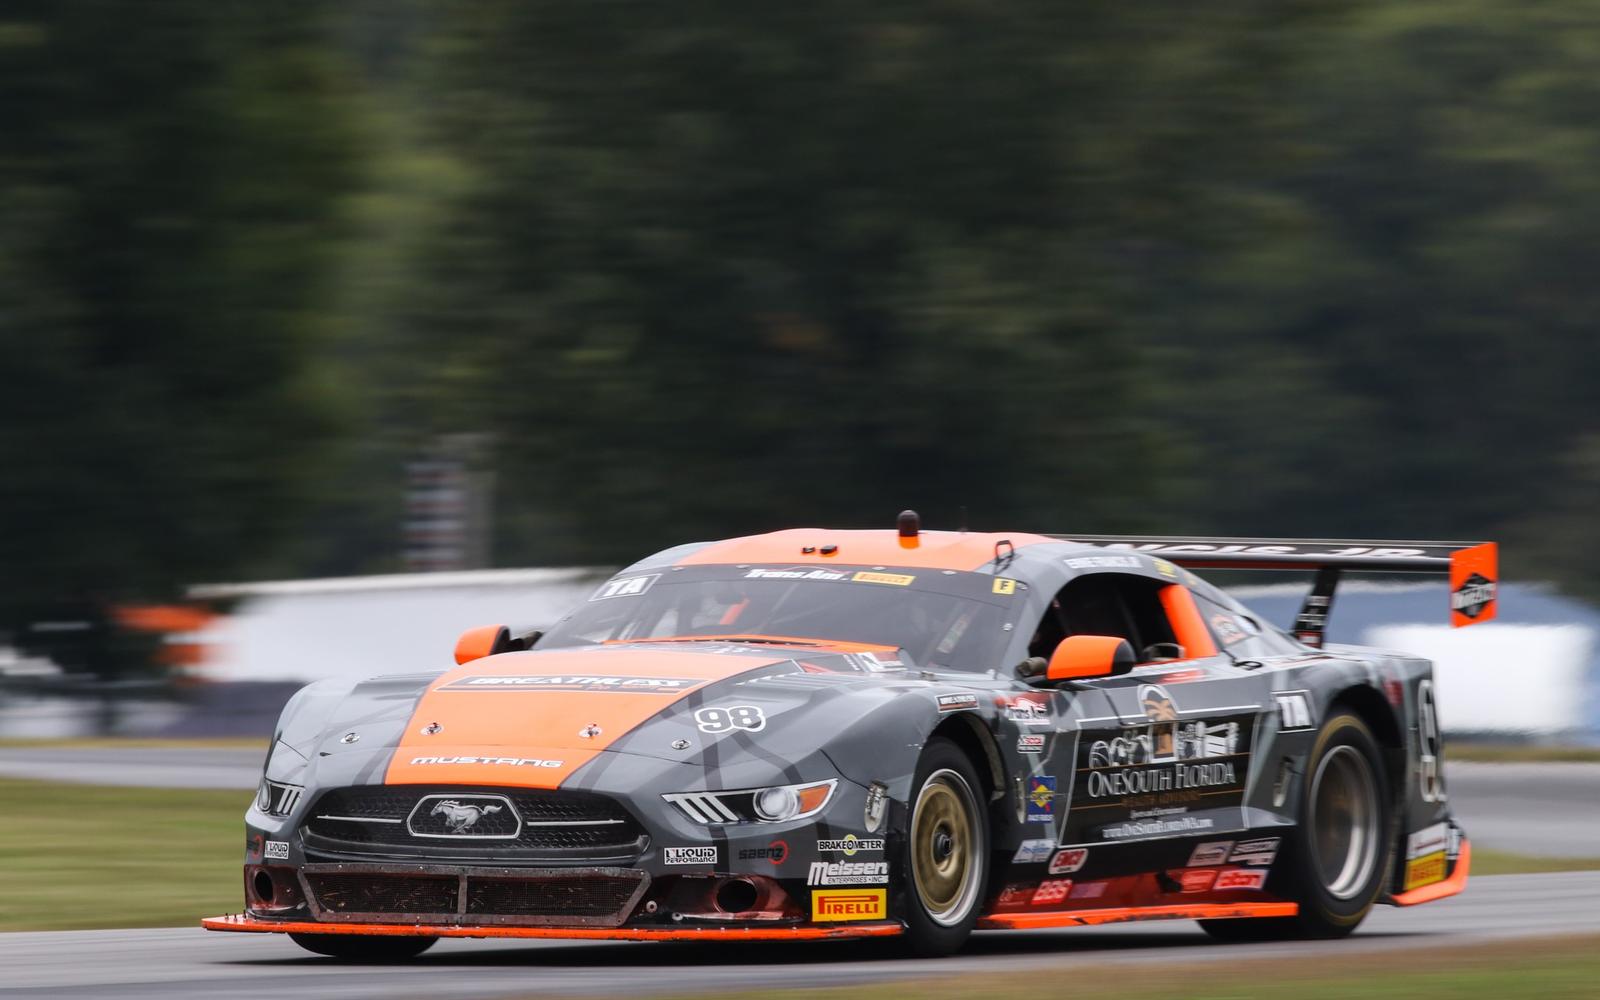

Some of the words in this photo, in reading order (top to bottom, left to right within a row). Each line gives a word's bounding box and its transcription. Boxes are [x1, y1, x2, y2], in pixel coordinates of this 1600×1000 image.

[602, 577, 649, 597] TA
[468, 676, 688, 688] BREATHLESS
[694, 705, 766, 733] 98
[410, 756, 564, 768] MUSTANG
[807, 860, 888, 886] Meissen
[817, 895, 879, 914] PIRELLI
